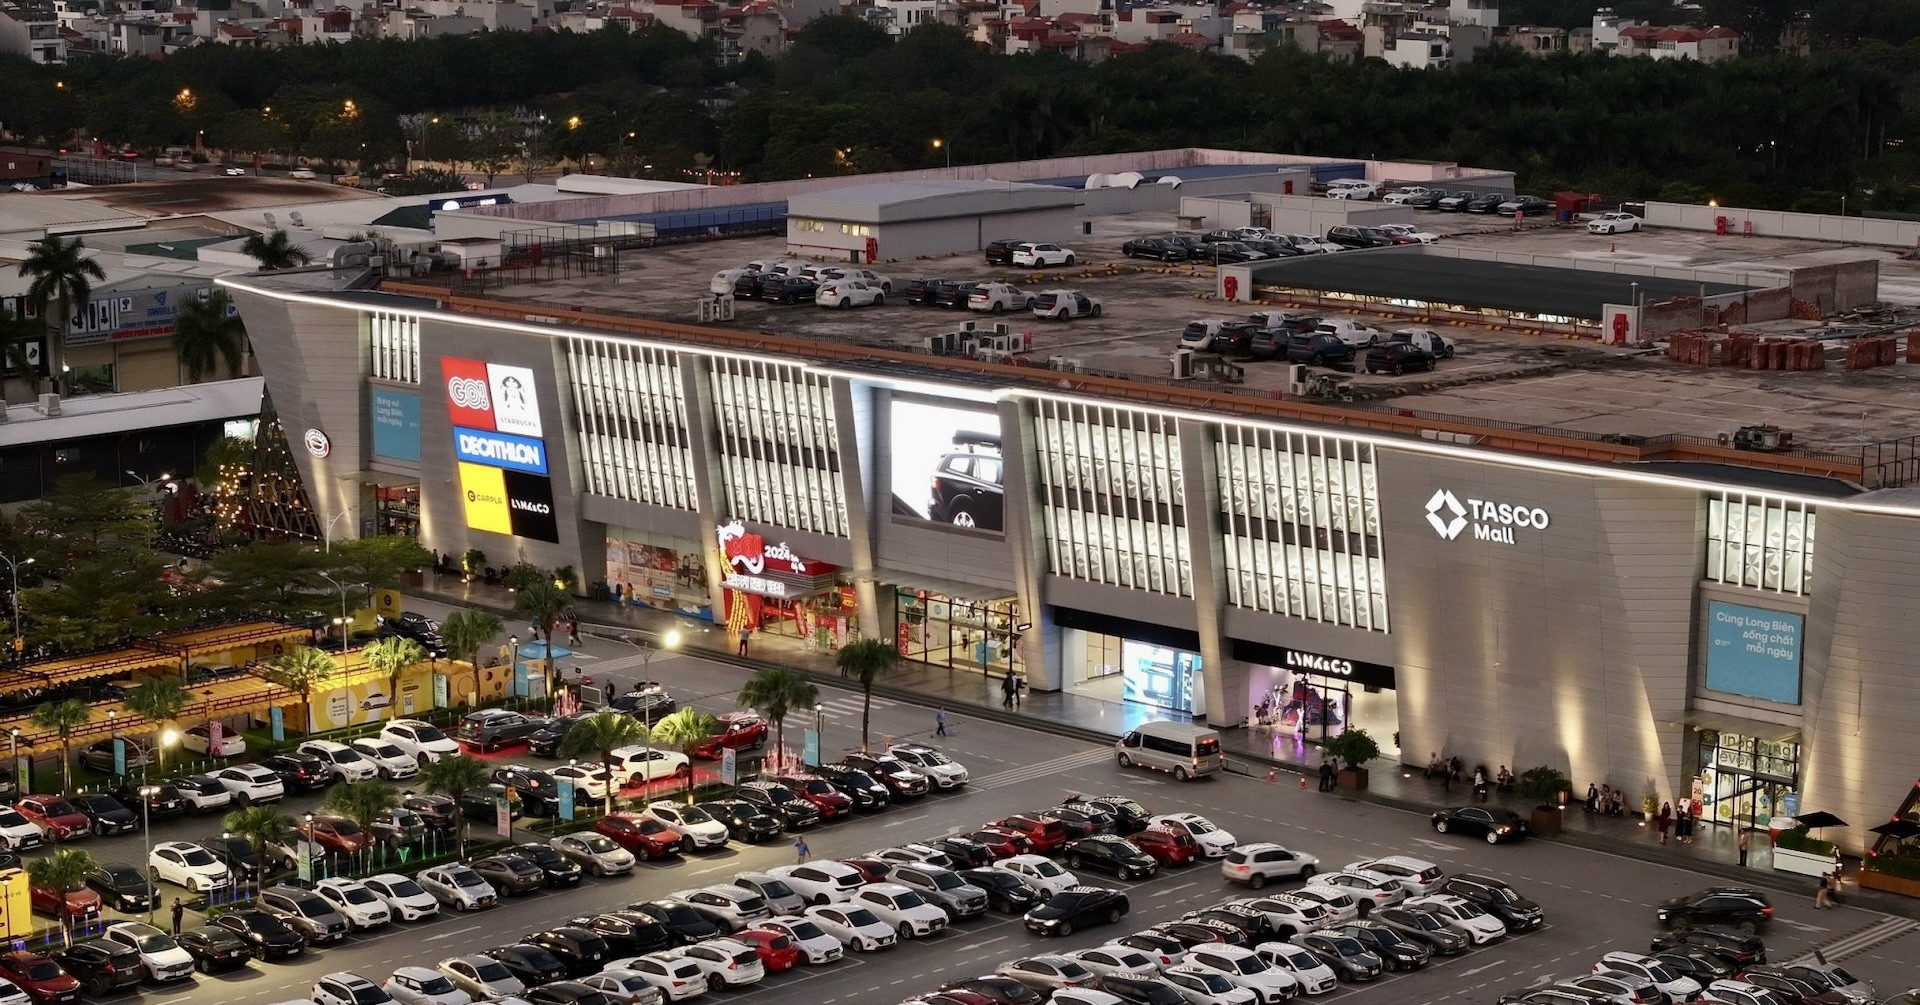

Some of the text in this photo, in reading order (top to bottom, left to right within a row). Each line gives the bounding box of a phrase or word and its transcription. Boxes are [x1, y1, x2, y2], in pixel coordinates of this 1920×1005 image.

[448, 376, 490, 411] GO!
[500, 418, 536, 427] STARBUCKS
[459, 434, 541, 466] DECATHLON
[477, 494, 502, 504] CARPLA
[1467, 499, 1549, 530] TASCO
[1474, 523, 1515, 544] Mall
[764, 544, 790, 561] 2024
[726, 573, 785, 596] HAPPY NEW YEAR
[1716, 612, 1795, 633] Cùng Long Biên
[1743, 629, 1768, 643] sống
[1770, 633, 1794, 646] chất
[1767, 647, 1793, 660] ngày
